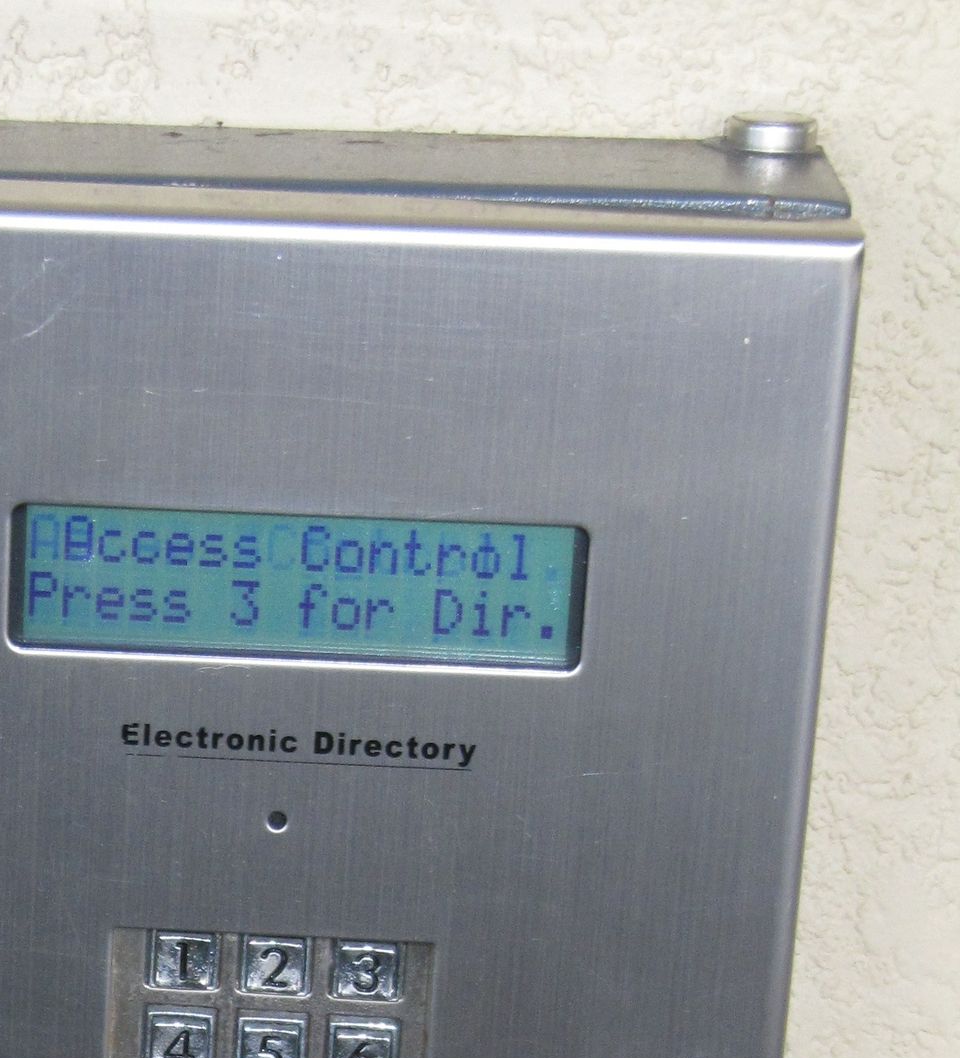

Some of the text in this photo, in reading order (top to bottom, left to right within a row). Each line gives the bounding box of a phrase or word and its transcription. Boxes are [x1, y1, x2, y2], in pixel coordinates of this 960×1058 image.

[27, 571, 553, 641] Press 3 for Dir.
[121, 723, 477, 768] Electronic Directory
[175, 941, 382, 994] 1 2 3
